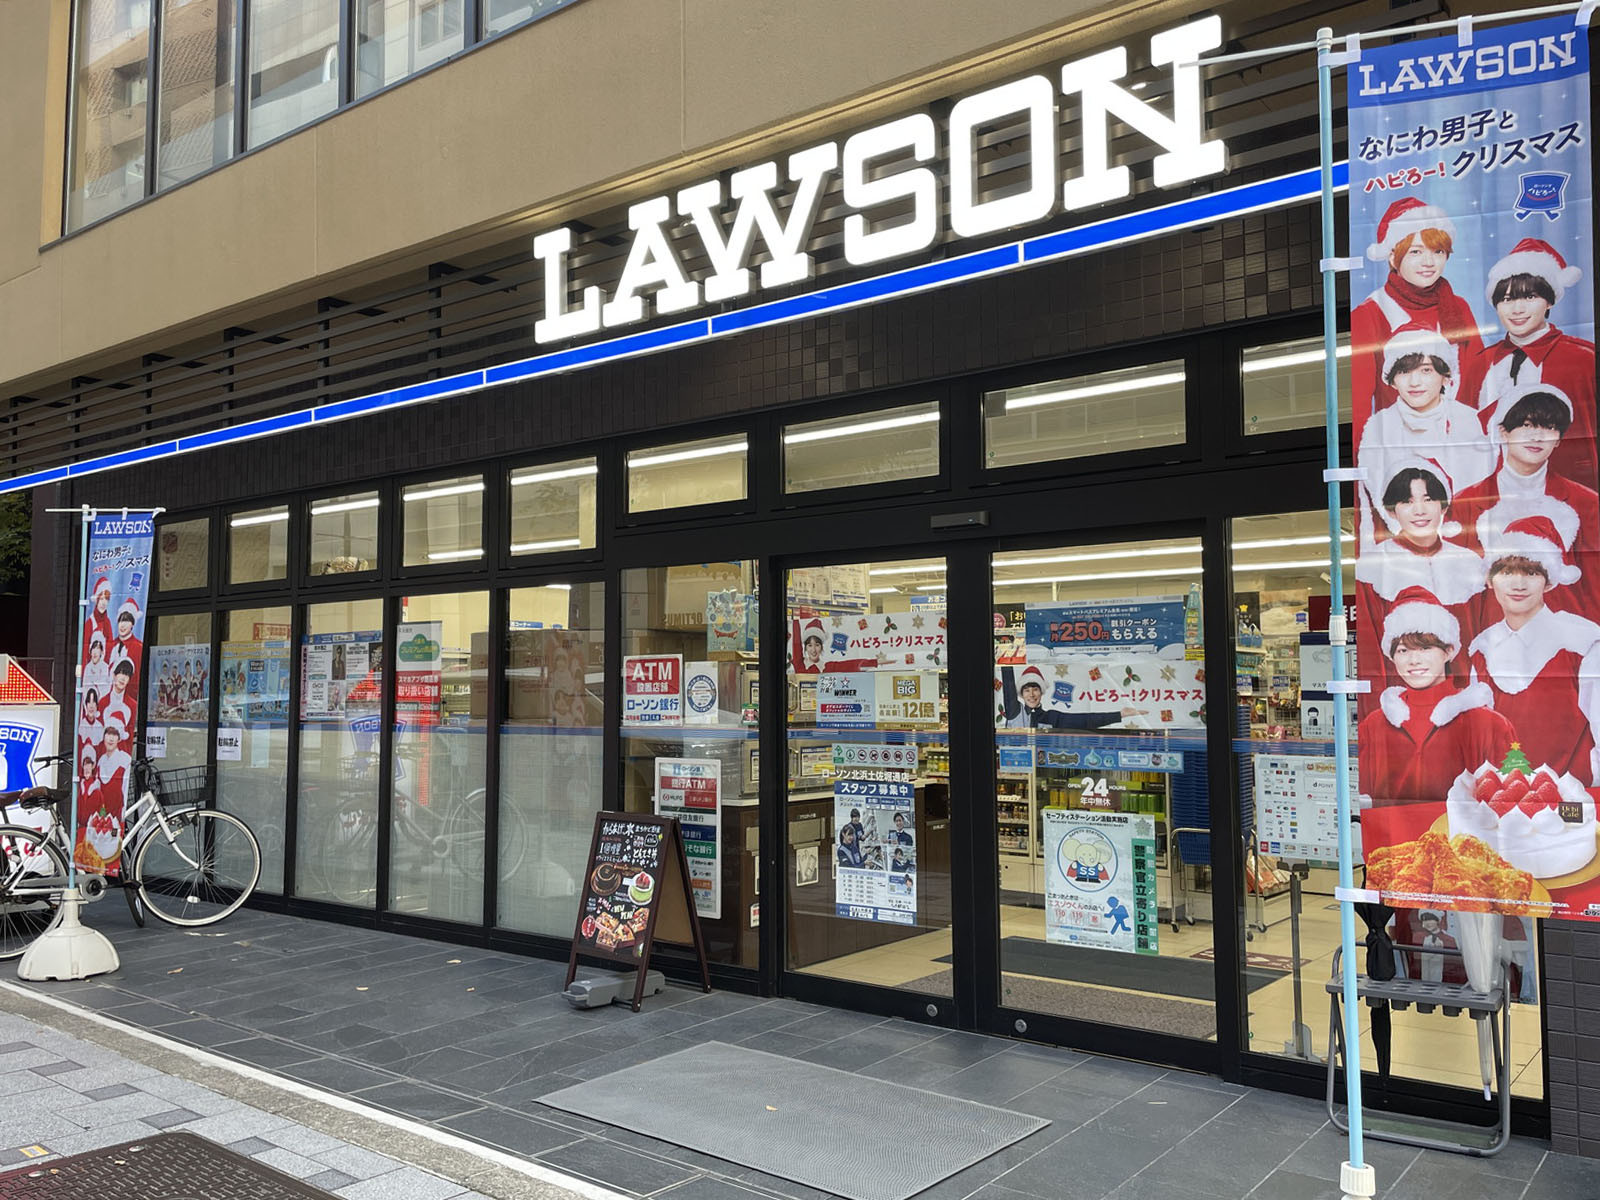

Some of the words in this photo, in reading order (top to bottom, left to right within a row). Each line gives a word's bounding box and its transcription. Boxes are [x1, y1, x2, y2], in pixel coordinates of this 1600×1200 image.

[1358, 31, 1577, 96] LAWSON
[1359, 108, 1514, 160] なにわ男子と
[1364, 162, 1446, 192] ハピろー!
[1452, 121, 1582, 178] クリスマス
[534, 15, 1229, 345] LAWSON
[94, 520, 153, 535] LAWSON
[1111, 627, 1158, 640] もらえる
[850, 634, 945, 649] ハピろー!クリスマス
[632, 661, 672, 681] ATM
[834, 689, 857, 697] WINNER
[897, 687, 916, 695] BIG
[1079, 688, 1204, 703] ハピろー!クリスマス
[627, 698, 679, 710] ローソン銀行
[0, 728, 35, 744] SON
[841, 782, 909, 796] スタッフ募集中
[1081, 776, 1109, 797] 24
[1080, 797, 1111, 807] 年中無休
[1079, 866, 1096, 876] SS
[1134, 845, 1149, 949] 警察官立寄り店舗
